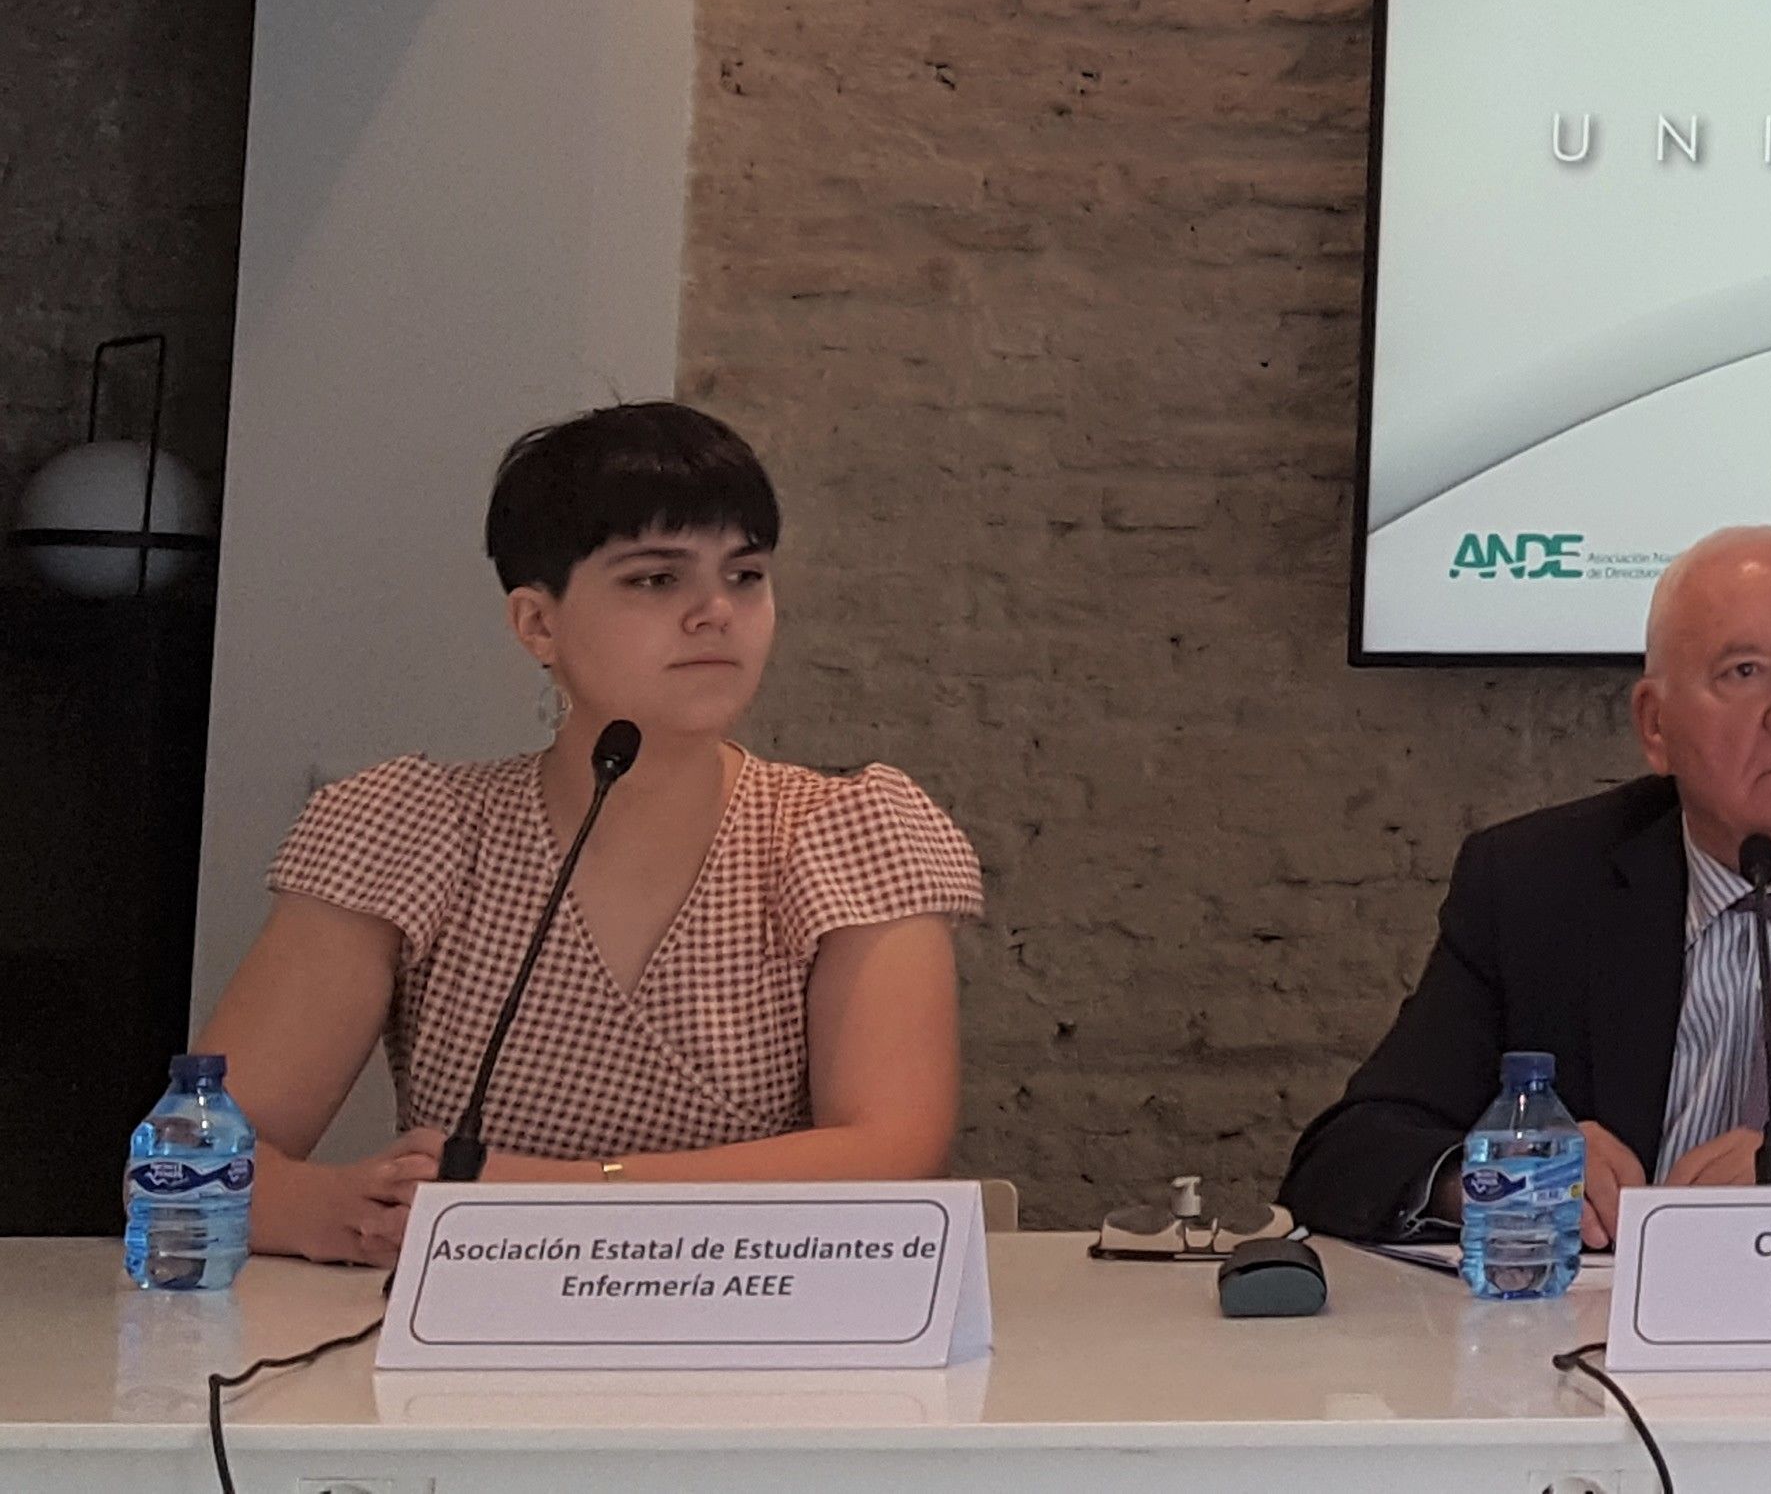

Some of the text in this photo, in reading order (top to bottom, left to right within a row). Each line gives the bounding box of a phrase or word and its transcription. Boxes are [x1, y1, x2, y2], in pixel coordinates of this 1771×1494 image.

[1448, 533, 1585, 580] ANDE
[431, 1235, 937, 1262] Asociación Estatal de Estudiantes de
[560, 1272, 796, 1298] Enfermería AEEE
